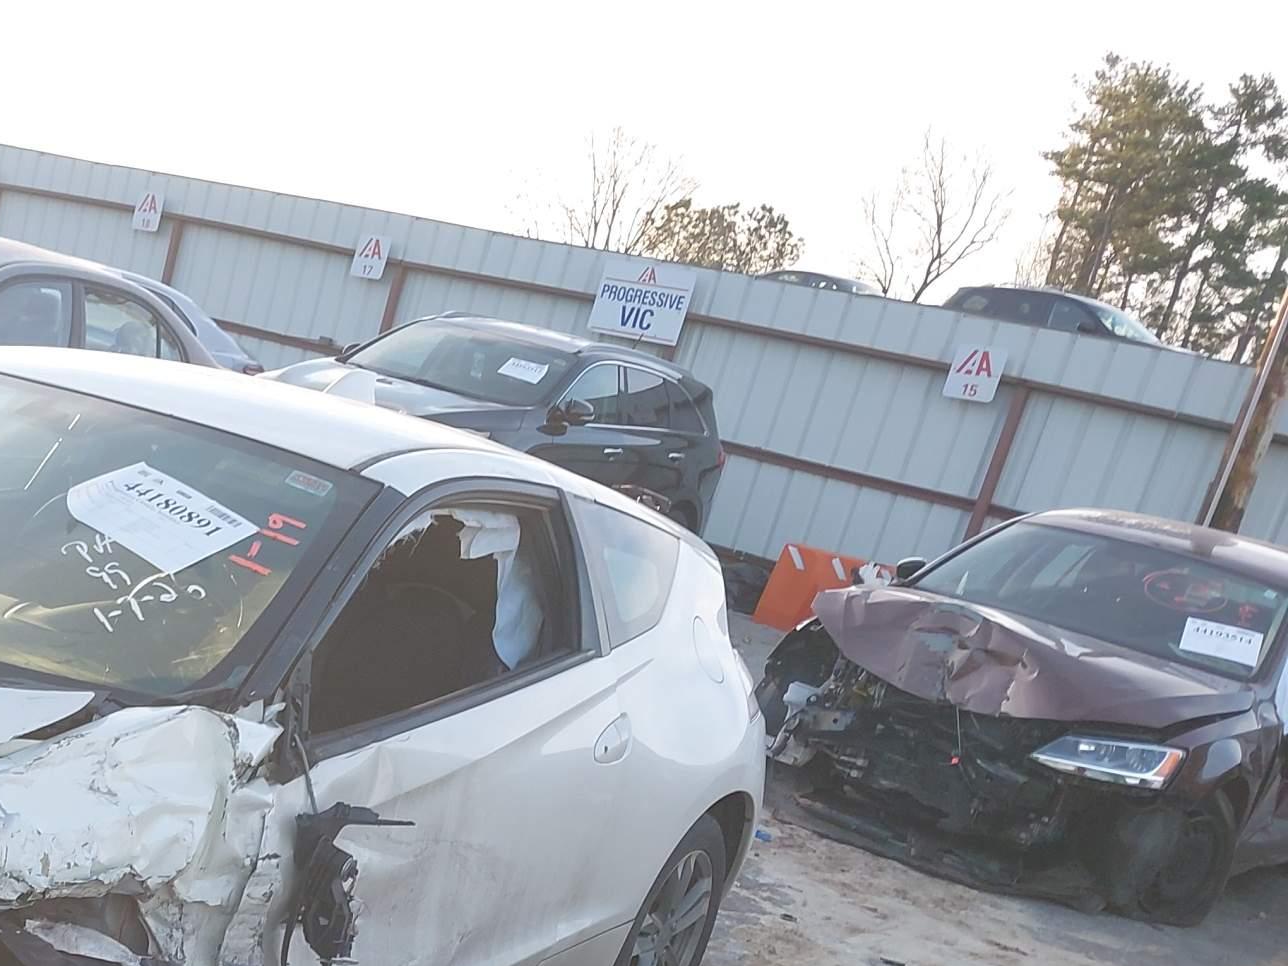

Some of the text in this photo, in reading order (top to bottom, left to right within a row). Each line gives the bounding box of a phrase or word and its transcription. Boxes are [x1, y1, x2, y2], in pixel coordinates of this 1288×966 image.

[363, 264, 374, 276] 17
[600, 283, 686, 311] PROGRESSIVE
[620, 305, 655, 331] VIC
[961, 383, 979, 397] 15
[123, 481, 225, 537] 44180891
[227, 512, 307, 576] 1-19
